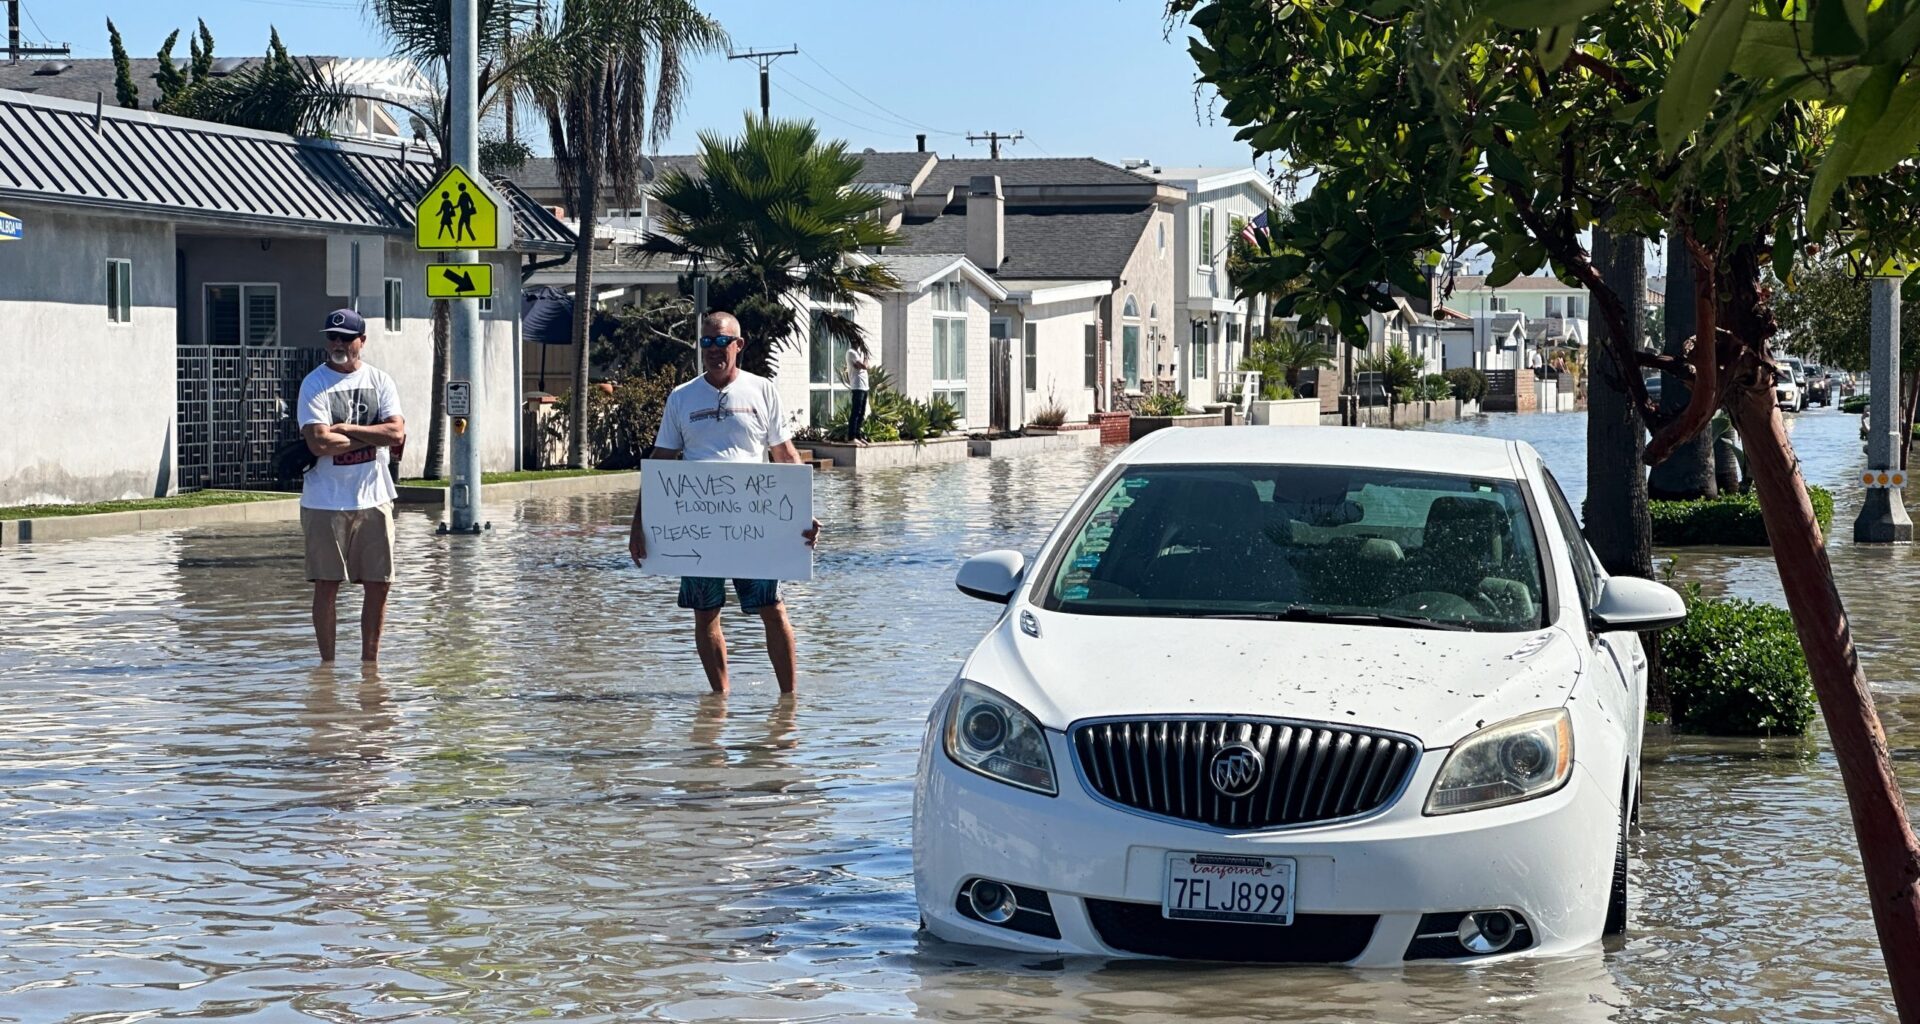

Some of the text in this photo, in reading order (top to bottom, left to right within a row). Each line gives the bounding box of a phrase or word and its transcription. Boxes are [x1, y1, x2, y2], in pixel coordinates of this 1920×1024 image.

[658, 470, 777, 499] WAVES ARE
[674, 500, 778, 516] FLOODING OUR
[651, 524, 765, 544] PLEASE TURN
[1192, 865, 1272, 879] California
[1174, 878, 1285, 914] 7FLJ899
